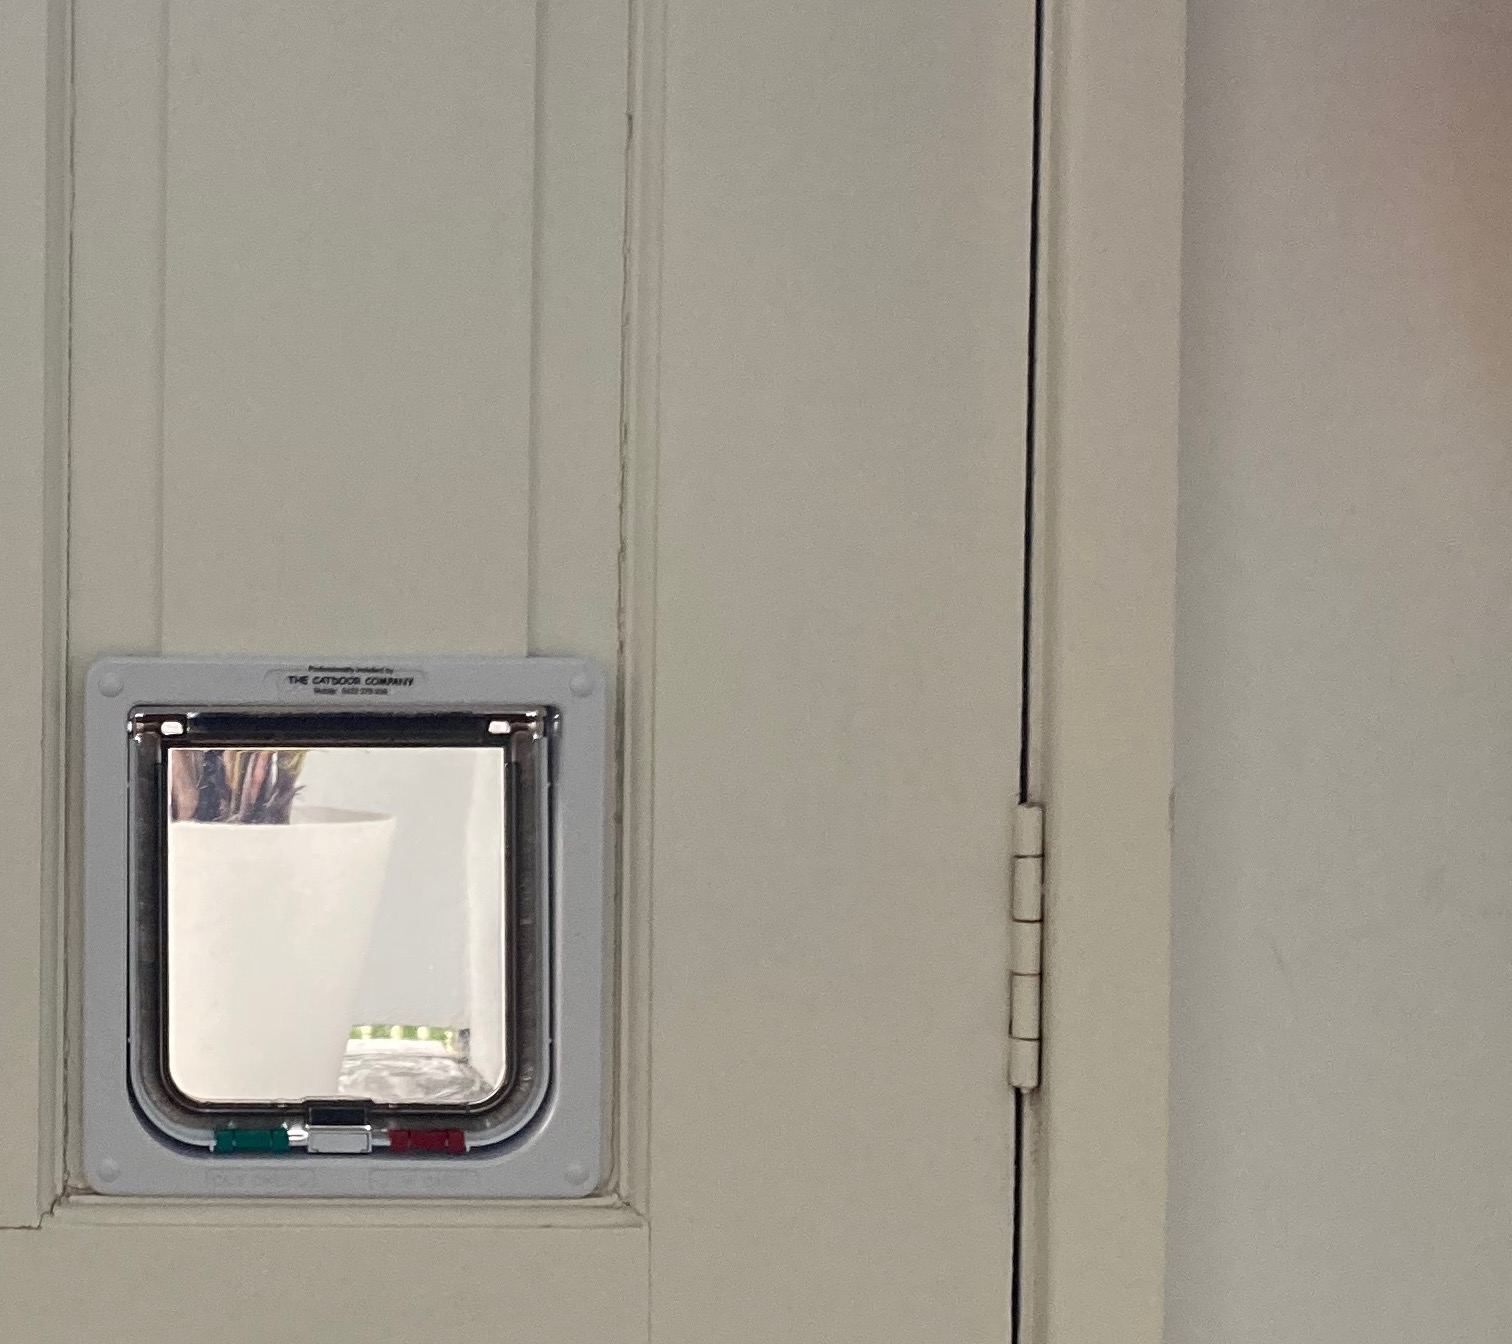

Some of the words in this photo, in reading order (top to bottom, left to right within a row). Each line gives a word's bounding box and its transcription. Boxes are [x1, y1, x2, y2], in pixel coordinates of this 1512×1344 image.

[288, 675, 309, 685] THE
[312, 675, 361, 685] CATDOOR
[365, 676, 414, 686] COMPANY
